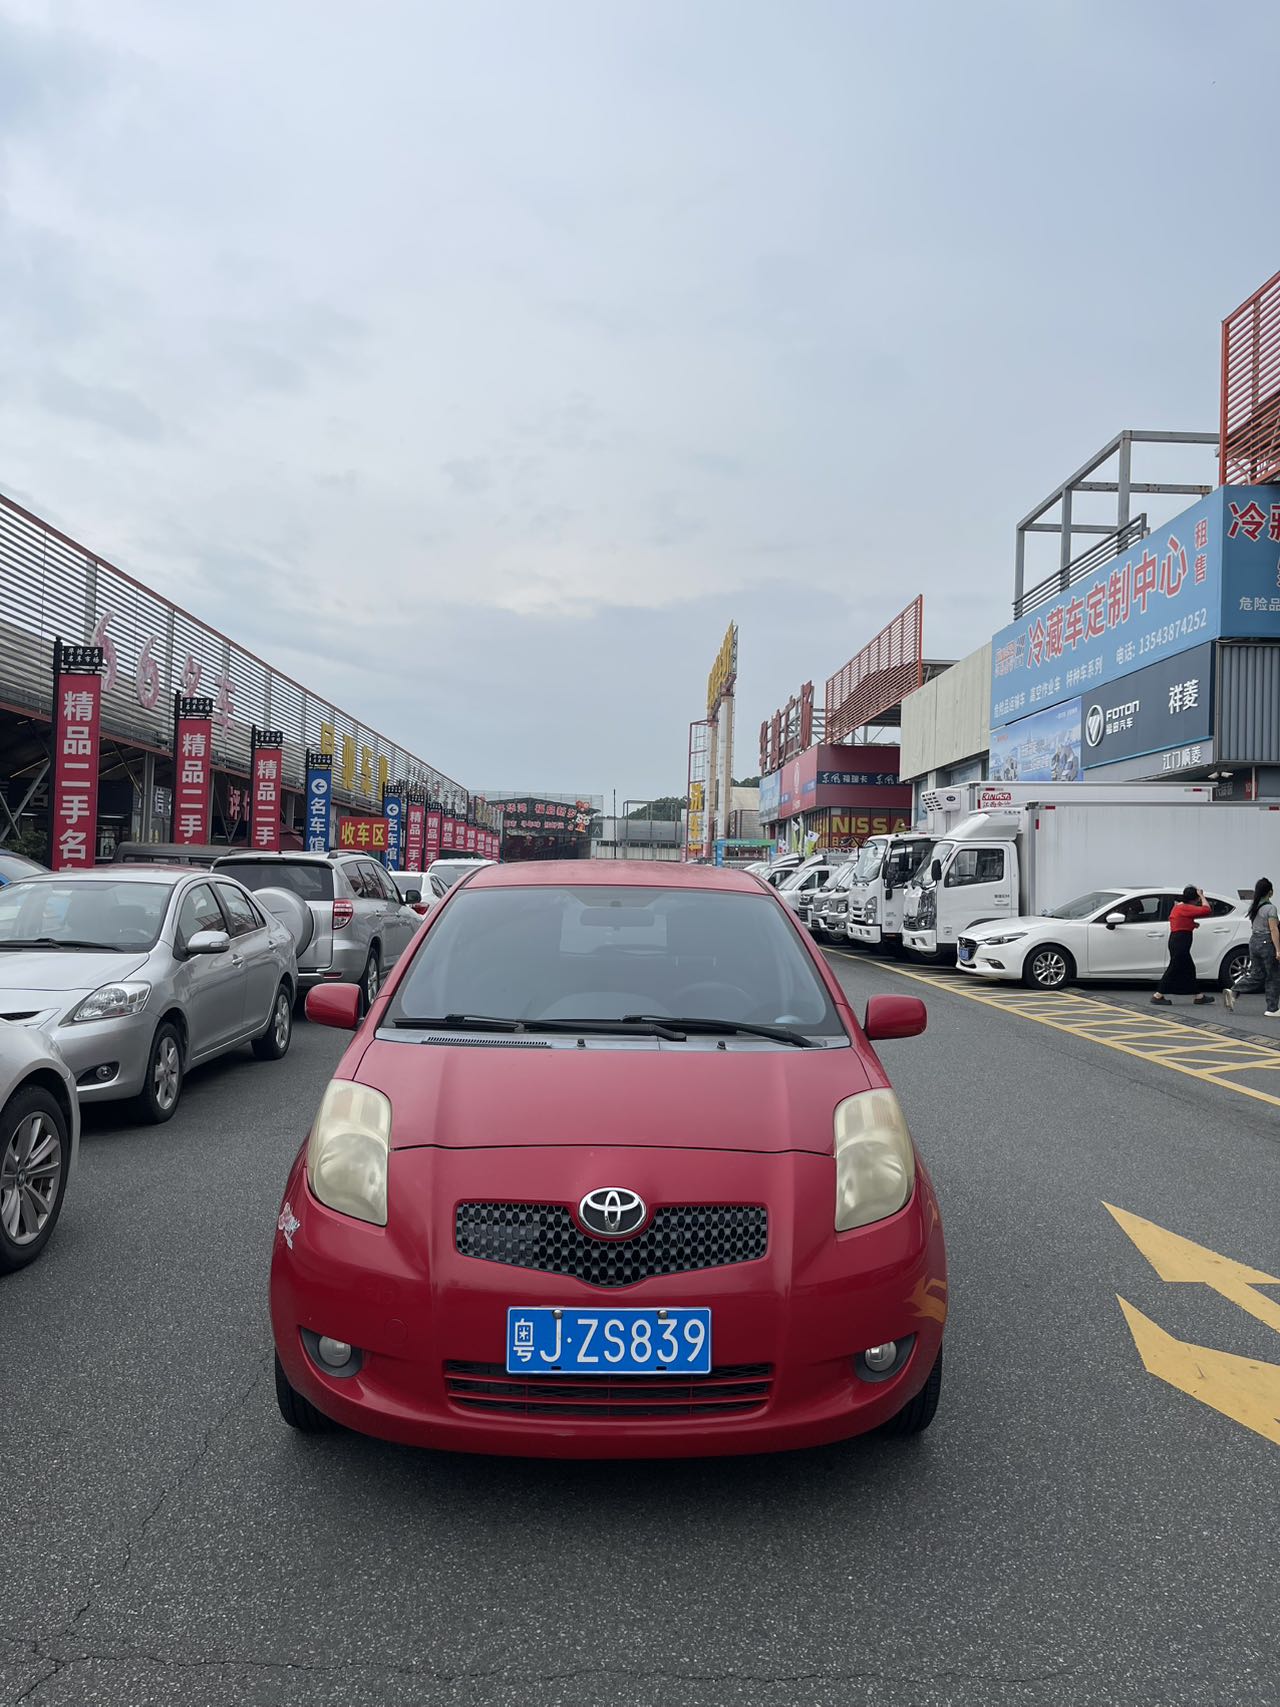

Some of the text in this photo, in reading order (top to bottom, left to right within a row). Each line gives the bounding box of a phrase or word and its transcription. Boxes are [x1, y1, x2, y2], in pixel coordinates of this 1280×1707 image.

[1194, 518, 1208, 586] 租售
[1026, 535, 1188, 669] 冷藏车定制中心
[1239, 597, 1280, 611] 危险品
[1106, 700, 1140, 722] FOTON
[1168, 679, 1200, 714] 祥菱
[59, 691, 94, 871] 精品二手名
[179, 733, 206, 843] 精品二手
[255, 759, 277, 845] 精品二手
[308, 797, 327, 852] 名车馆
[341, 821, 385, 846] 收车区
[426, 818, 438, 867] 精品二手
[513, 1318, 706, 1363] 粤J·ZS839
